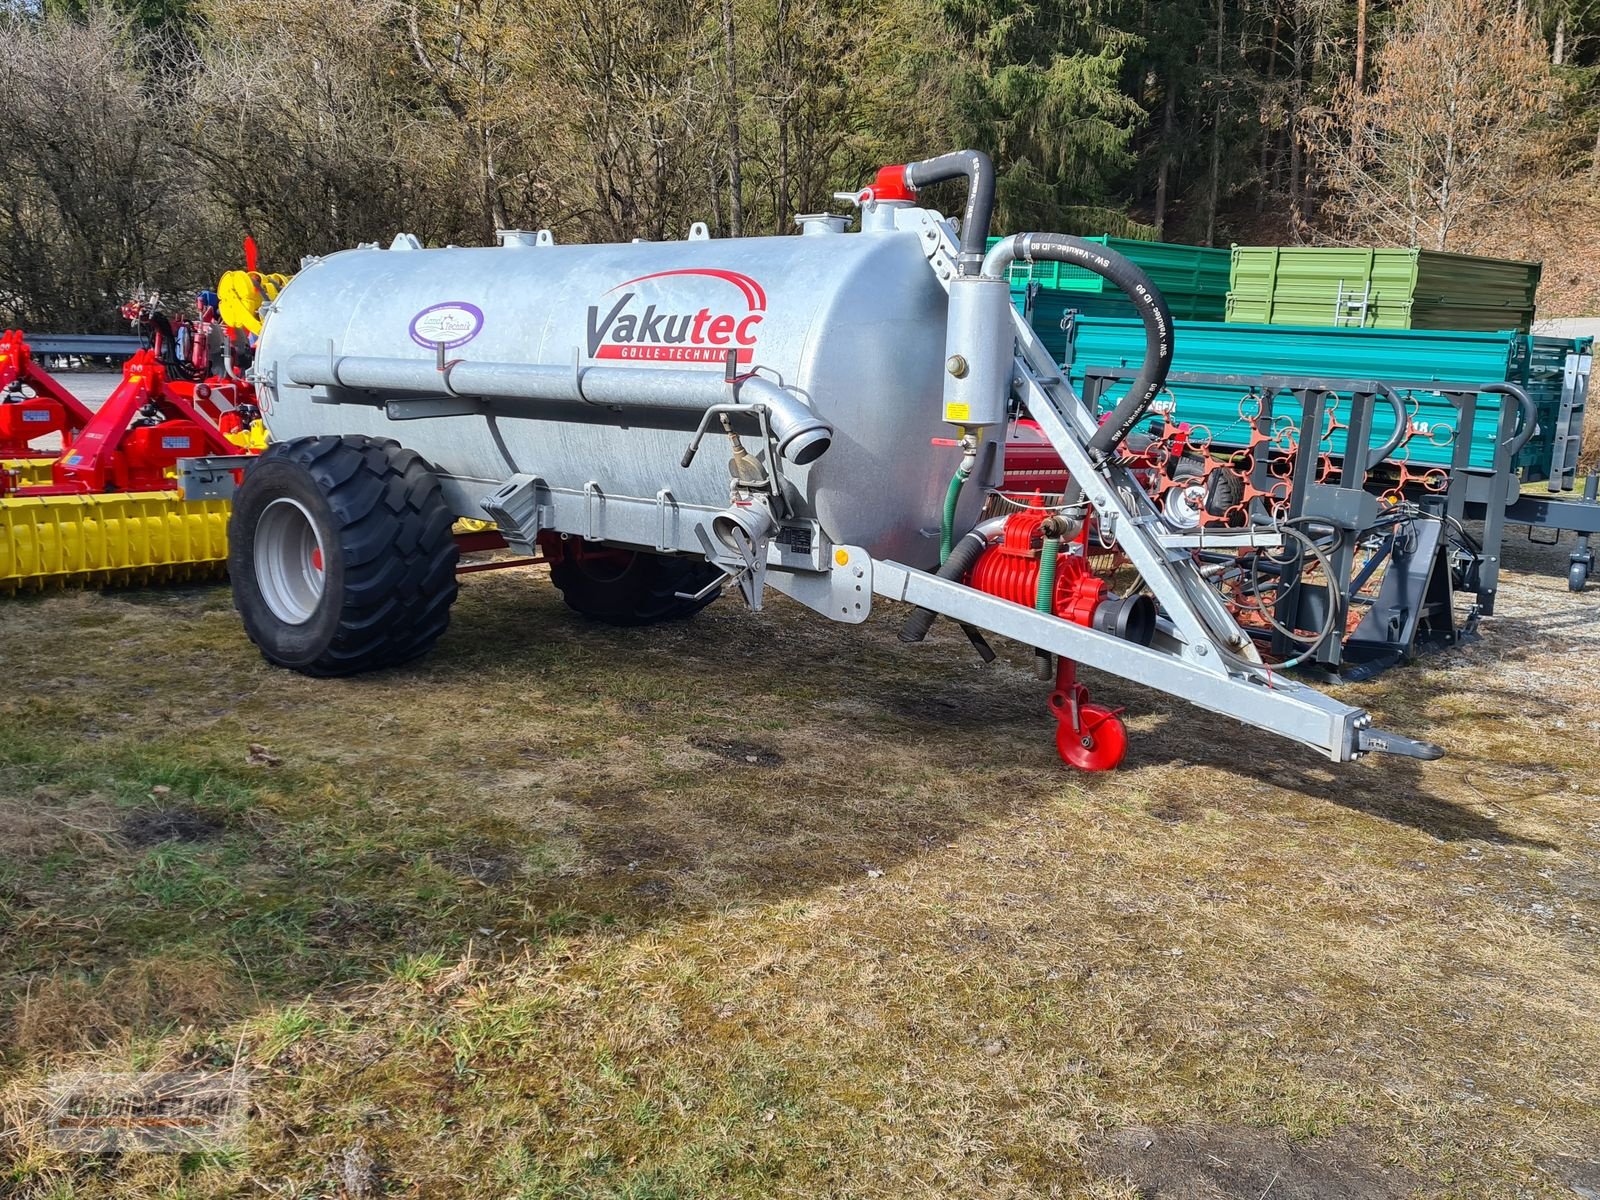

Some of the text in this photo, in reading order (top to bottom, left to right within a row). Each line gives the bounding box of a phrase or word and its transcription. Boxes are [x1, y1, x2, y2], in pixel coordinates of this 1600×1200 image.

[1057, 243, 1089, 259] Vakutec
[1095, 256, 1111, 268] SW
[1135, 284, 1147, 295] 80
[1143, 293, 1153, 304] ID
[587, 293, 764, 359] Vakutec
[1153, 306, 1167, 338] Vakutec
[1112, 430, 1123, 442] SW
[1123, 404, 1145, 427] Vakutec
